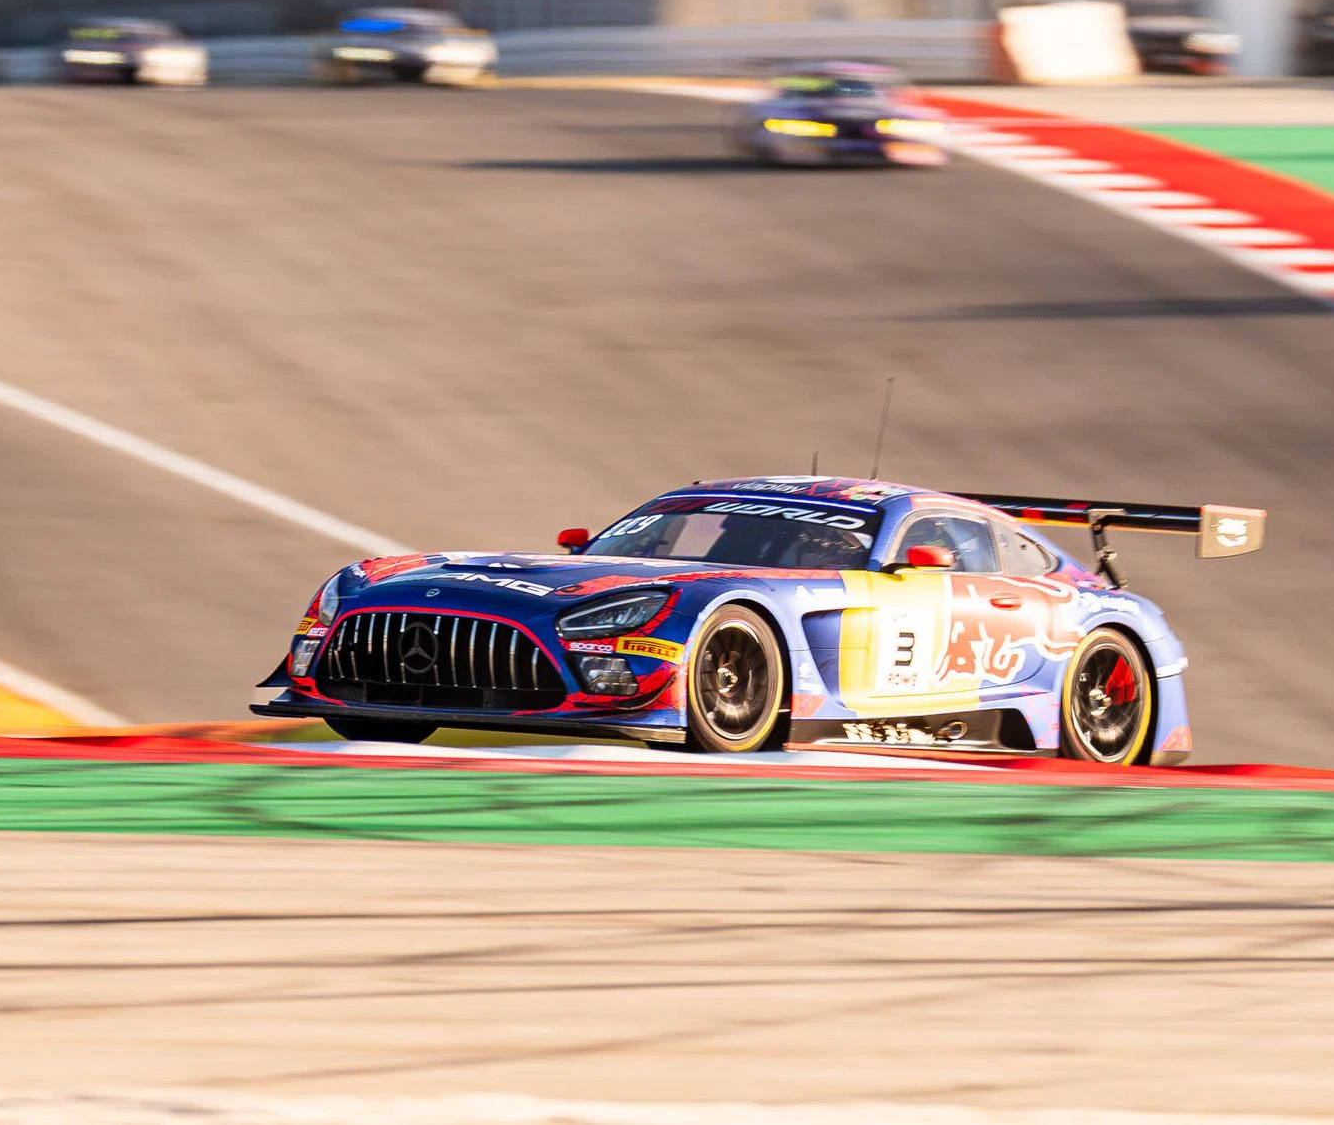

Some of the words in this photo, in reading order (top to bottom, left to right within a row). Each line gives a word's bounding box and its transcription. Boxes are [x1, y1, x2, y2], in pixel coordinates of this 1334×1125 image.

[732, 481, 807, 494] viaplay
[704, 502, 866, 530] WORLD
[434, 573, 555, 597] AMG
[569, 641, 614, 654] sparco
[622, 639, 678, 659] PIRELLI
[894, 631, 916, 667] 3
